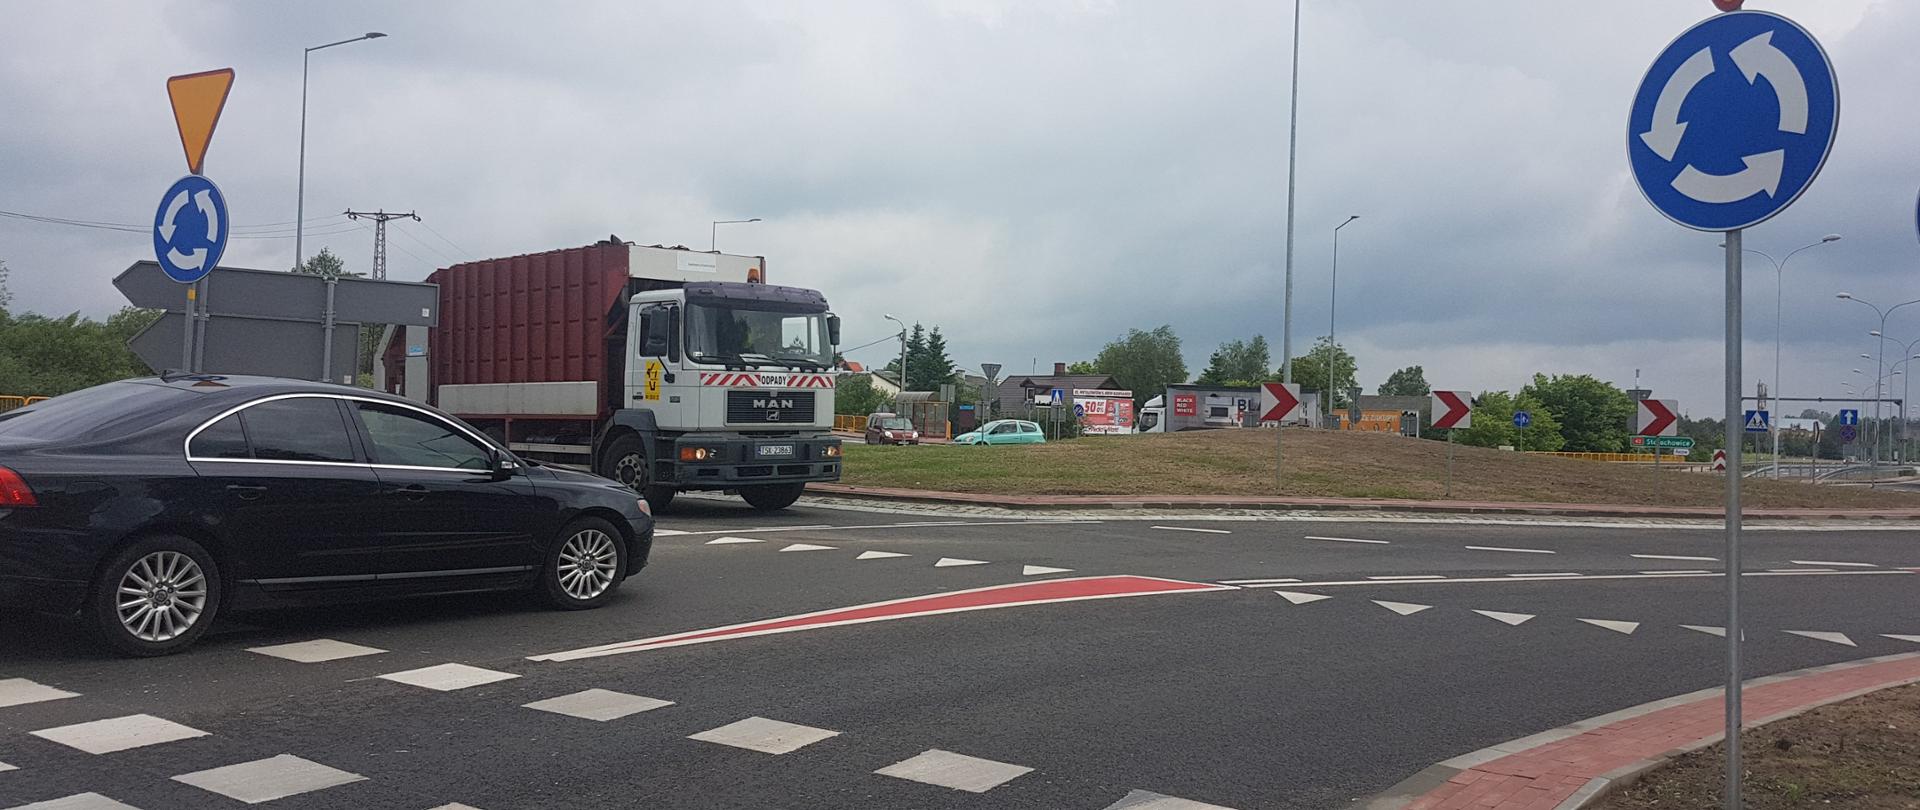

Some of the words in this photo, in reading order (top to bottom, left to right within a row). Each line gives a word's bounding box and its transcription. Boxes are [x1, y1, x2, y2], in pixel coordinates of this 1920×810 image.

[761, 375, 786, 385] ODPADY
[753, 399, 793, 409] MAN
[1085, 401, 1096, 412] 50
